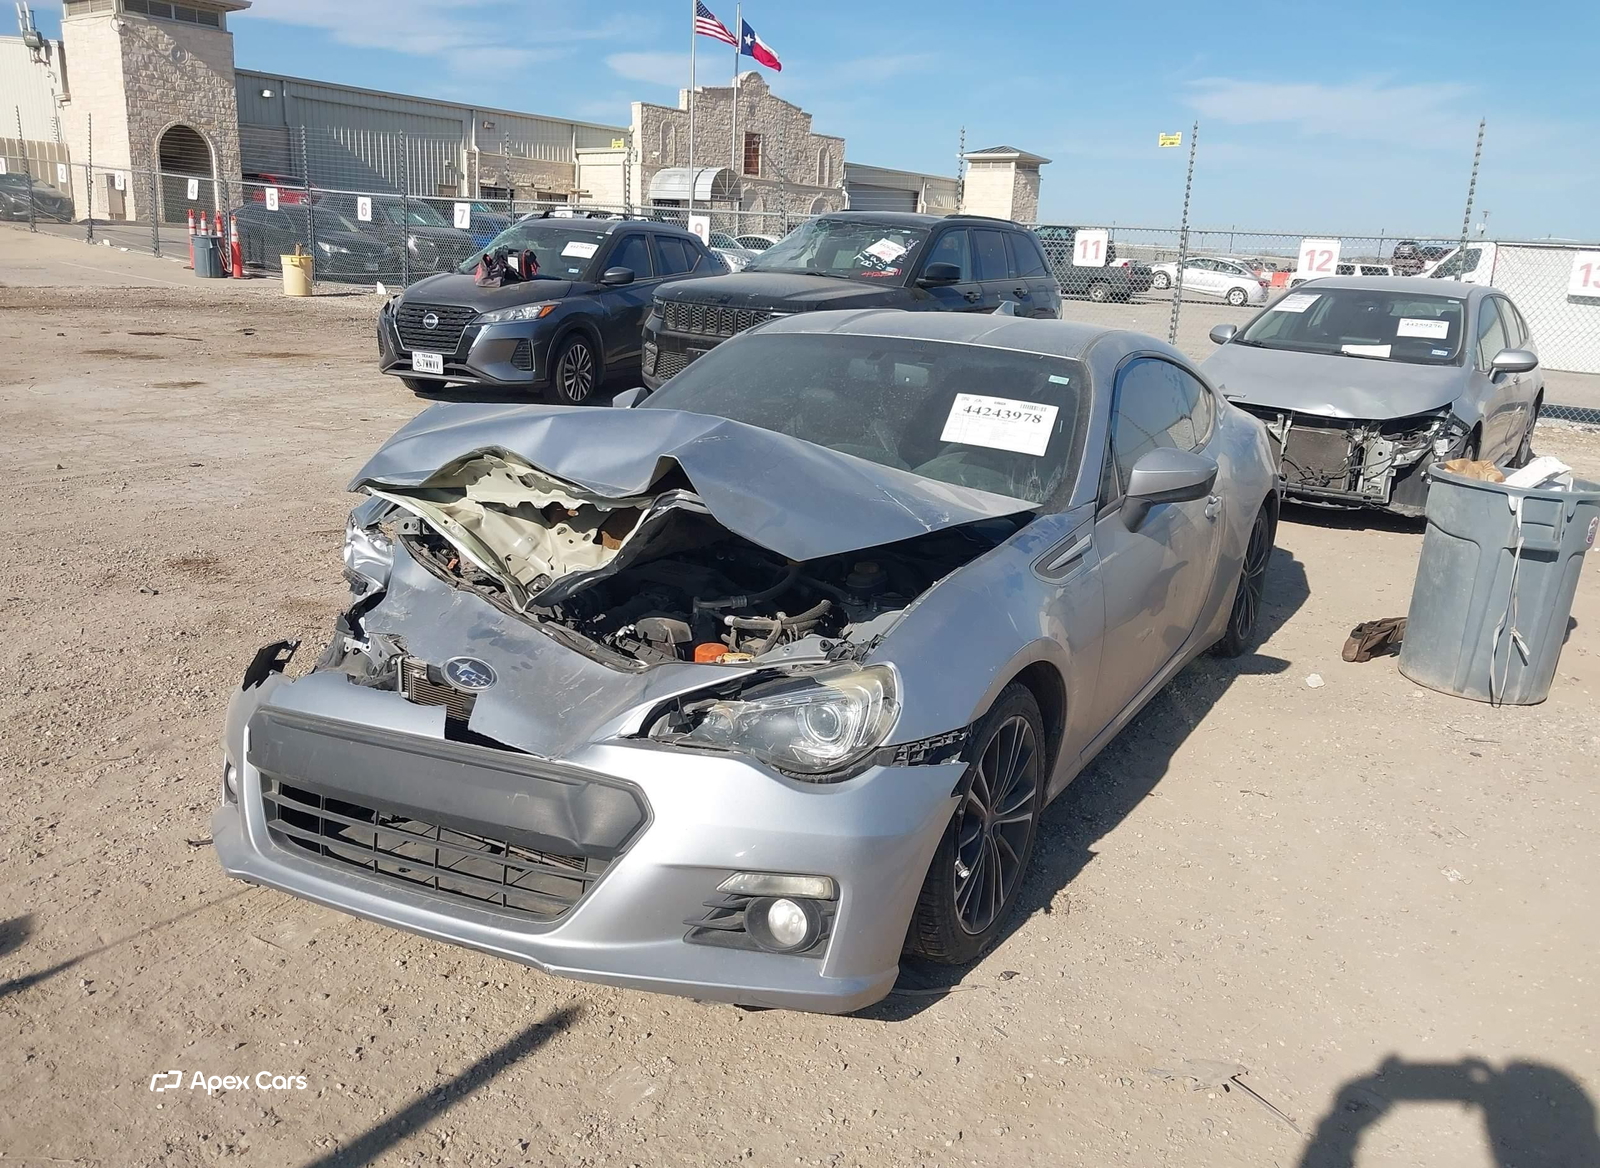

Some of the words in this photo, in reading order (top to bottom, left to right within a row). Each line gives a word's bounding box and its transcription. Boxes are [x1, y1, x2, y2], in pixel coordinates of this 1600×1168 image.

[60, 168, 65, 179] 2
[116, 174, 122, 187] 3
[189, 183, 195, 197] 4
[269, 193, 275, 207] 5
[360, 202, 368, 217] 6
[458, 209, 466, 224] 7
[694, 222, 703, 237] 9
[1079, 239, 1101, 260] 11
[1305, 249, 1334, 272] 12
[963, 404, 1043, 424] 44243978
